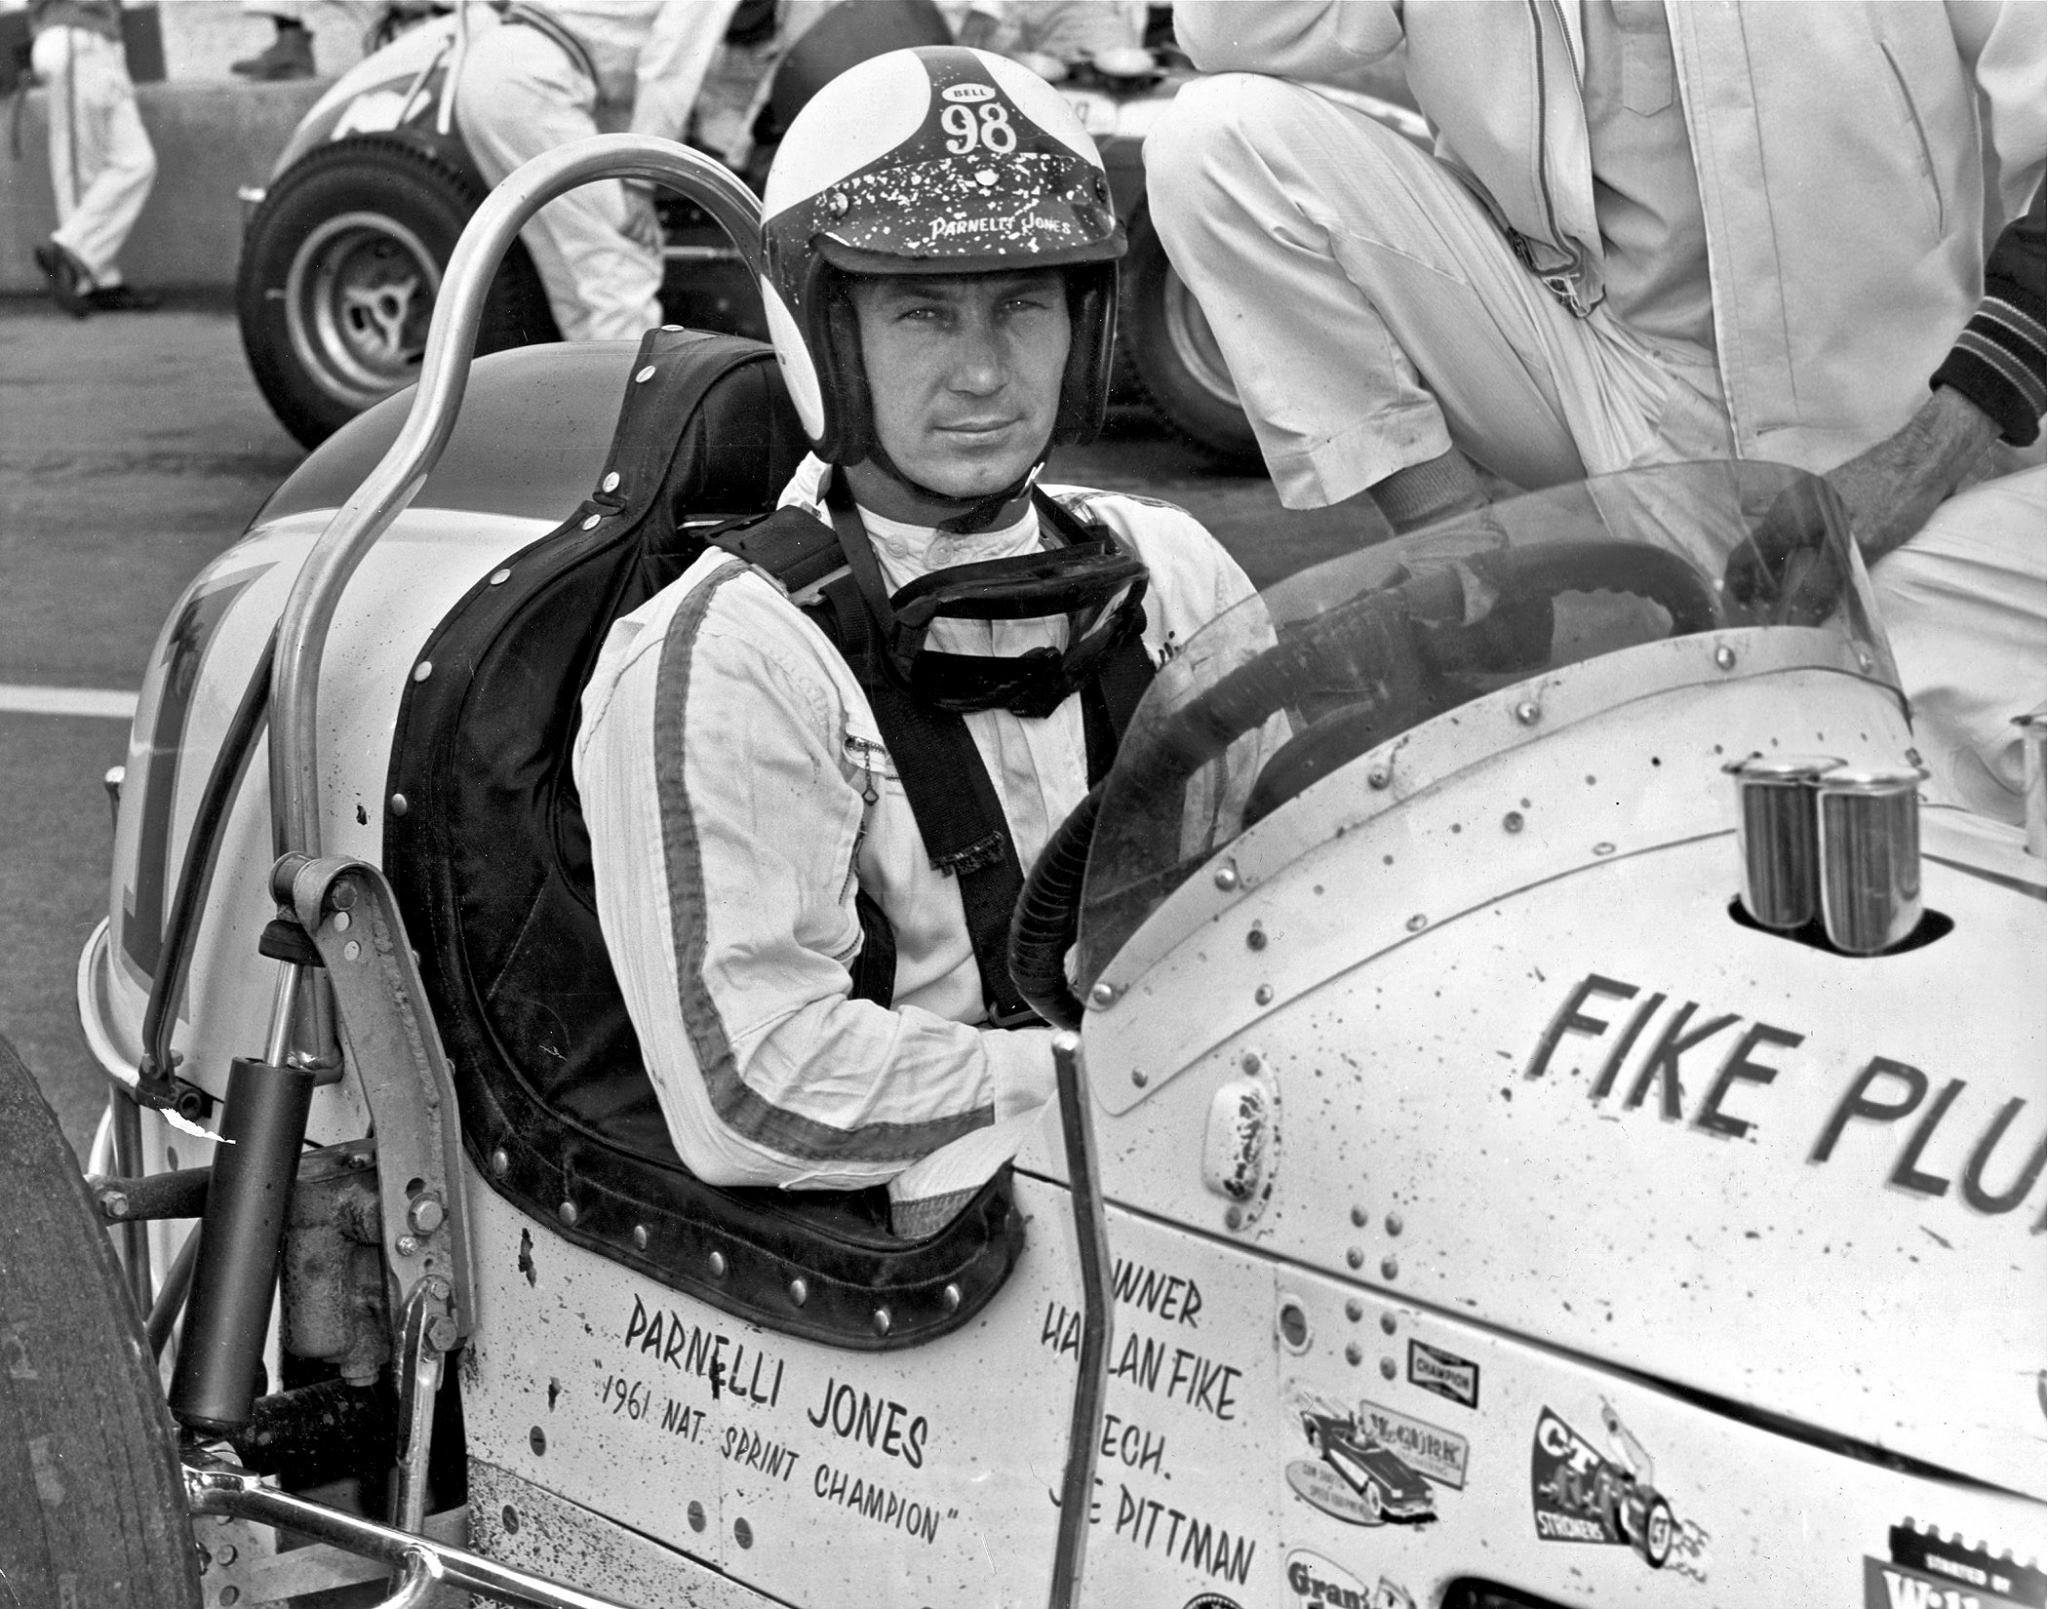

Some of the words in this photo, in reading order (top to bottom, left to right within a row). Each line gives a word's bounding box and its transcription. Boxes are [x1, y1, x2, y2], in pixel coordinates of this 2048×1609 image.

[952, 87, 988, 98] BELL
[941, 103, 1017, 154] 98
[1020, 211, 1071, 235] JONES
[1523, 972, 1806, 1139] FIKE
[1805, 1055, 2047, 1235] PLU
[1112, 1257, 1203, 1329] WNER
[624, 1292, 785, 1408] PARNELLI
[806, 1376, 928, 1470] JONES
[1041, 1300, 1166, 1393] HAAN
[1167, 1348, 1243, 1421] FIKE
[720, 1425, 800, 1482] SPRINT
[1100, 1413, 1172, 1481] ECH.
[1115, 1483, 1257, 1586] PITTMAN
